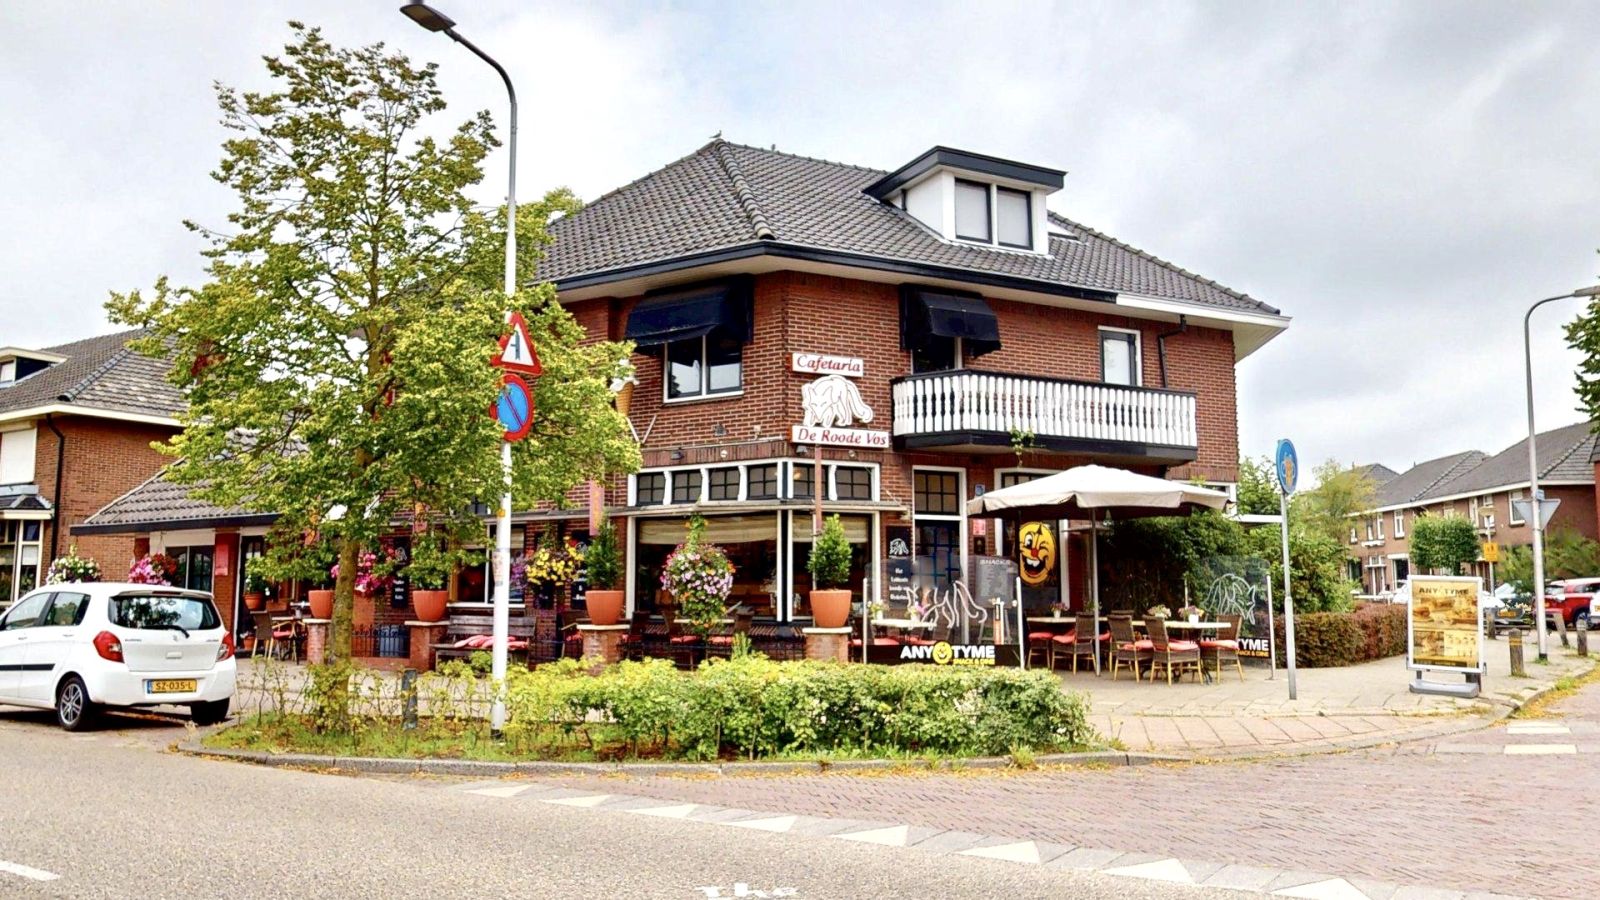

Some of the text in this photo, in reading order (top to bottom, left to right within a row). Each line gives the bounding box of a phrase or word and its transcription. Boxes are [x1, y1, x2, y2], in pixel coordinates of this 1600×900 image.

[797, 355, 861, 372] Cafetaria
[797, 428, 887, 446] De Roode Vos
[900, 646, 995, 659] ANY TYME
[155, 681, 193, 690] SZ-035-L
